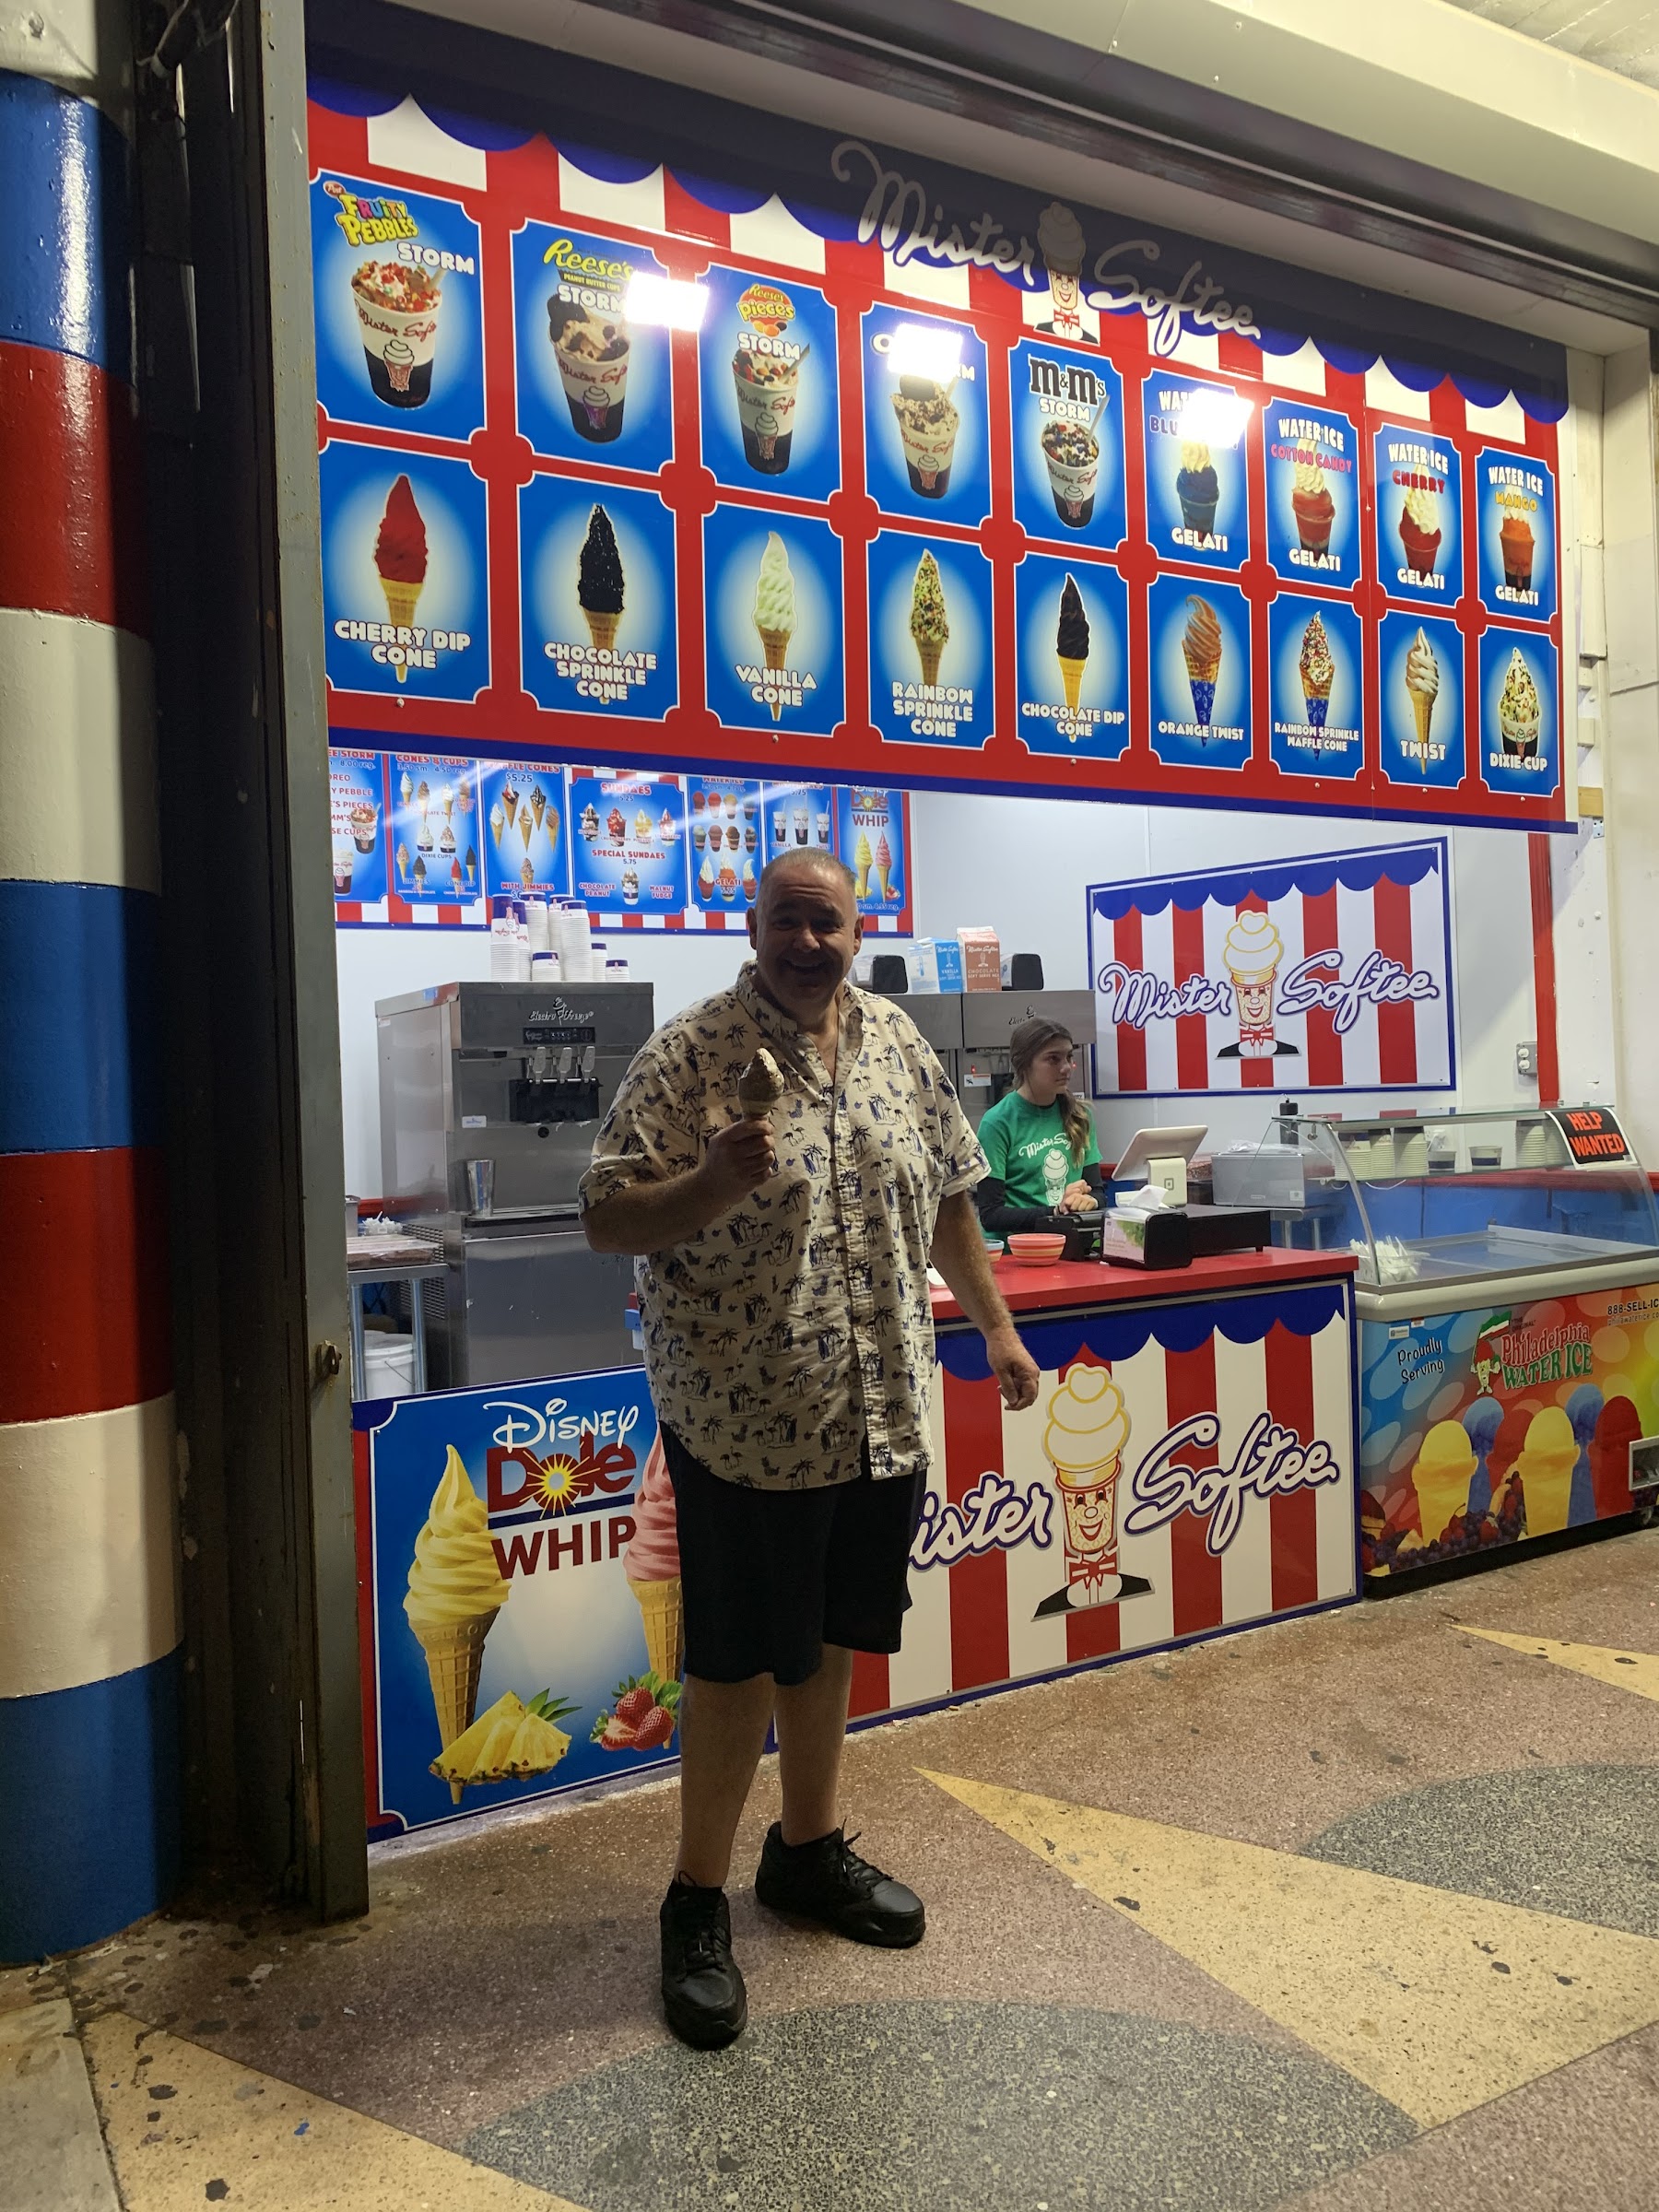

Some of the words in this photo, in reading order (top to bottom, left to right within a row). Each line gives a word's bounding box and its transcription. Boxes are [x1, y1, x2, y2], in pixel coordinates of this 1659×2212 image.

[336, 214, 418, 246] PEBBLES
[397, 242, 475, 275] STORM
[544, 239, 634, 281] Reese's
[831, 140, 1035, 287] Mister
[1086, 239, 1261, 358] Softee
[563, 273, 584, 284] PEANUT
[558, 285, 628, 313] STORM
[737, 332, 800, 360] STORM
[1039, 398, 1090, 421] STORM
[1278, 418, 1322, 442] WATER
[1324, 425, 1345, 453] ICE
[1270, 443, 1315, 465] COTTON
[1315, 453, 1352, 473] CANDY
[1388, 443, 1428, 466] WATER
[1430, 450, 1449, 475] ICE
[1393, 469, 1445, 494] CHERRY
[1488, 466, 1524, 487] WATER
[1526, 471, 1544, 496] ICE
[1495, 490, 1537, 512] MANGO
[1171, 527, 1229, 552] GELATI
[1288, 547, 1341, 571] GELATI
[1397, 568, 1444, 590] GELATI
[1495, 585, 1539, 606] GELATI
[334, 619, 427, 647] CHERRY
[431, 629, 471, 651] DIP
[371, 644, 437, 669] CONE
[544, 641, 657, 670] CHOCOLATE
[556, 661, 646, 686] SPRINKLE
[735, 665, 818, 689] VANILLA
[576, 679, 628, 700] CONE
[751, 686, 803, 707] CONE
[891, 680, 973, 705] RAINBOW
[892, 700, 973, 722] SPRINKLE
[1020, 702, 1101, 723] CHOCOLATE
[1103, 711, 1125, 725] DIP
[911, 719, 957, 737] CONE
[1056, 721, 1093, 736] CONE
[1158, 721, 1209, 737] ORANGE
[1211, 725, 1244, 741] TWIST
[1274, 722, 1317, 737] RAINBOW
[1318, 725, 1359, 741] SPRINKLE
[340, 749, 375, 759] STORM
[1287, 735, 1322, 748] WAFFLE
[1324, 739, 1347, 752] CONE
[1400, 739, 1446, 761] TWIST
[396, 754, 429, 763] CONES
[443, 758, 468, 766] CUPS
[527, 763, 560, 773] CONES
[1489, 752, 1548, 771] DIXIE-CUP
[506, 772, 533, 782] $5.25
[600, 782, 652, 795] SUNDAES
[343, 801, 373, 809] PIECES
[853, 814, 888, 827] WHIP
[592, 849, 625, 858] SPECIAL
[628, 851, 665, 859] SUNDAES
[579, 882, 616, 890] CHOCOLATE
[714, 878, 741, 887] GELATI
[1098, 960, 1232, 1030] Mister
[1277, 948, 1441, 1035] Softee
[1566, 1112, 1602, 1131] HELP
[1018, 1137, 1053, 1159] Mister
[1569, 1133, 1625, 1157] WANTED
[1397, 1337, 1442, 1366] Proudly
[1500, 1323, 1590, 1366] Philadelphia
[1401, 1359, 1444, 1383] Serving
[1501, 1348, 1562, 1390] WATER
[1565, 1341, 1593, 1378] ICE
[486, 1430, 638, 1512] Dole
[907, 1470, 1053, 1571] ister
[1124, 1410, 1340, 1556] Softee
[489, 1515, 638, 1580] WHIP
